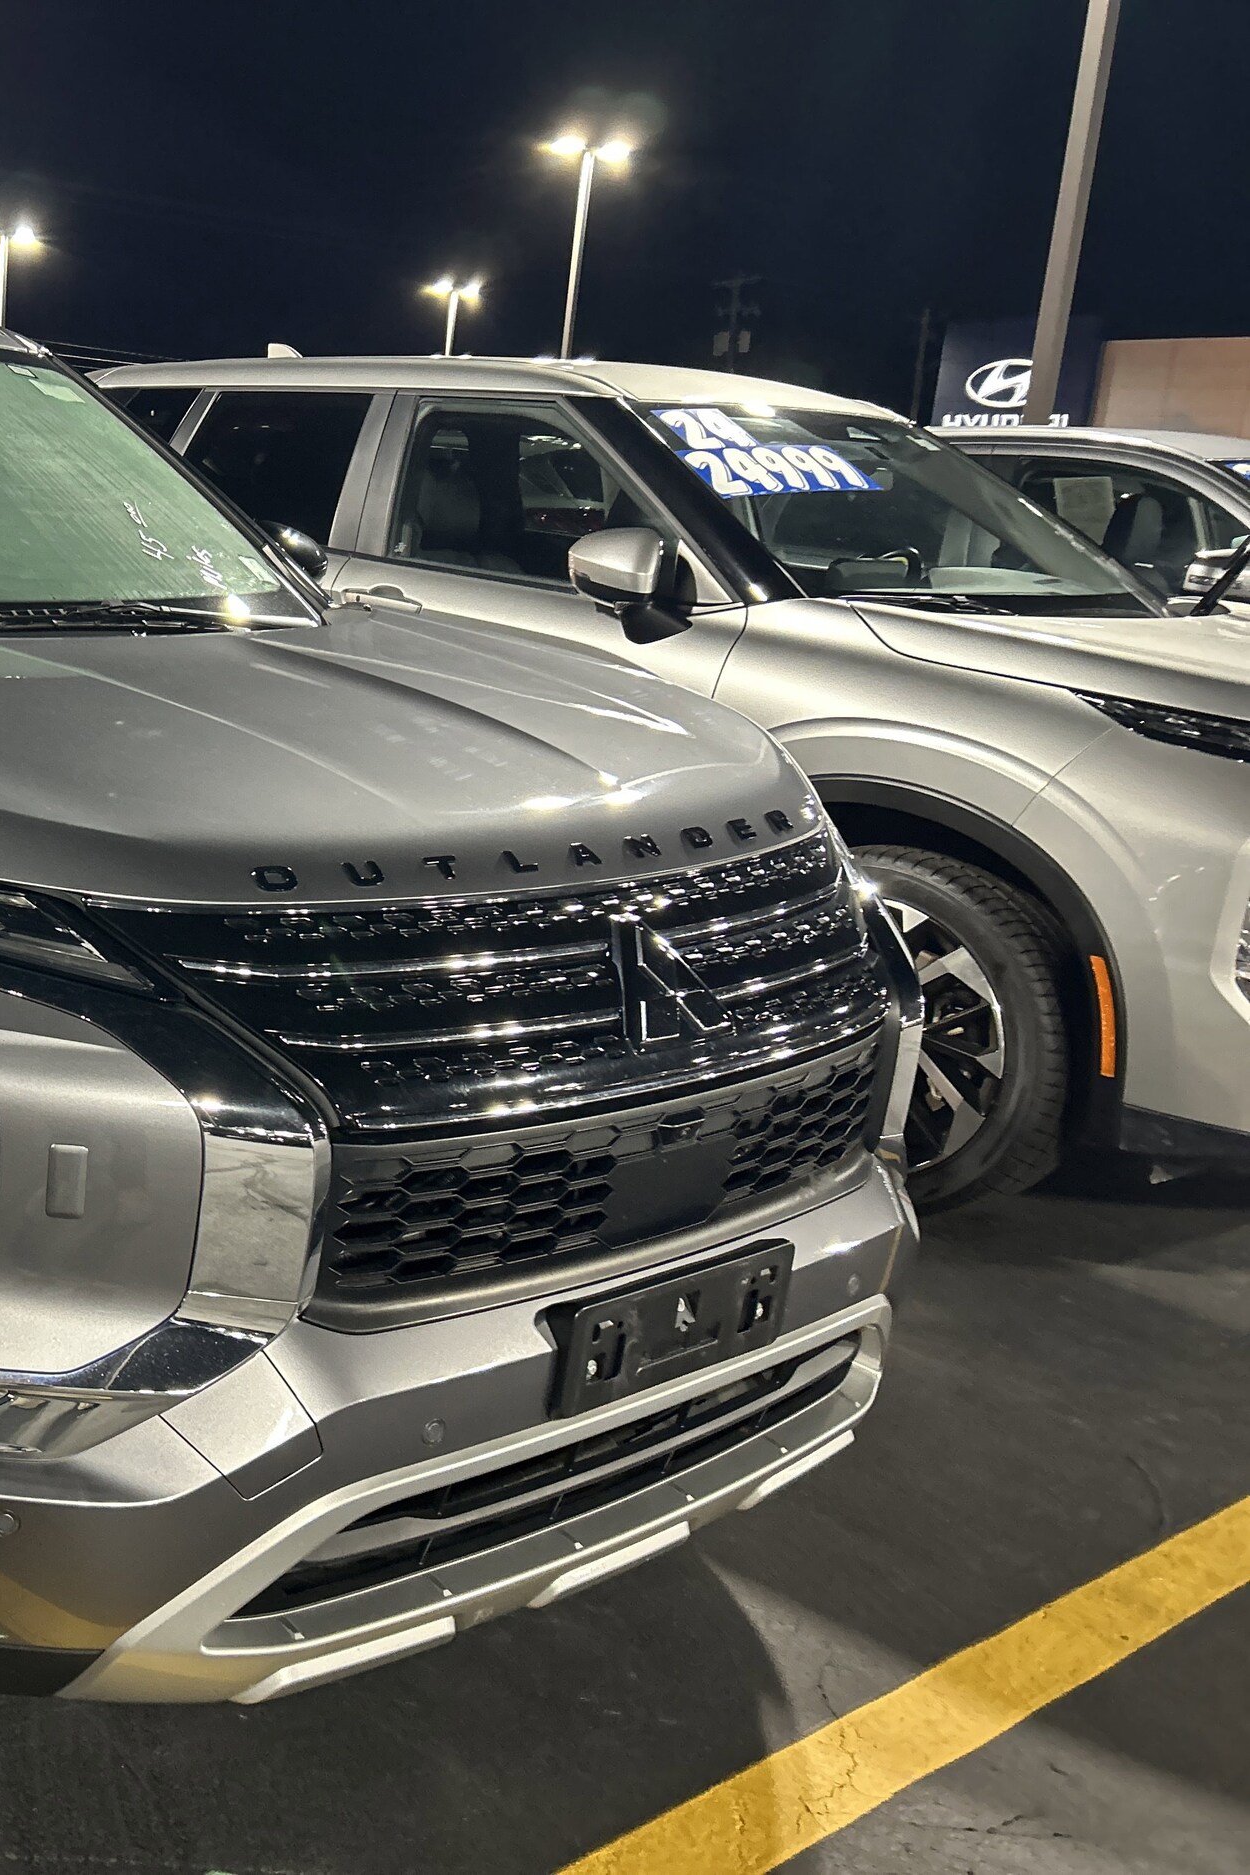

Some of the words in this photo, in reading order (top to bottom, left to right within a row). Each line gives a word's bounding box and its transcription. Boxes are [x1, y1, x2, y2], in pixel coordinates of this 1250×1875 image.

[659, 409, 757, 450] 24
[684, 447, 870, 496] 24999
[250, 809, 793, 892] OUTLANDER
